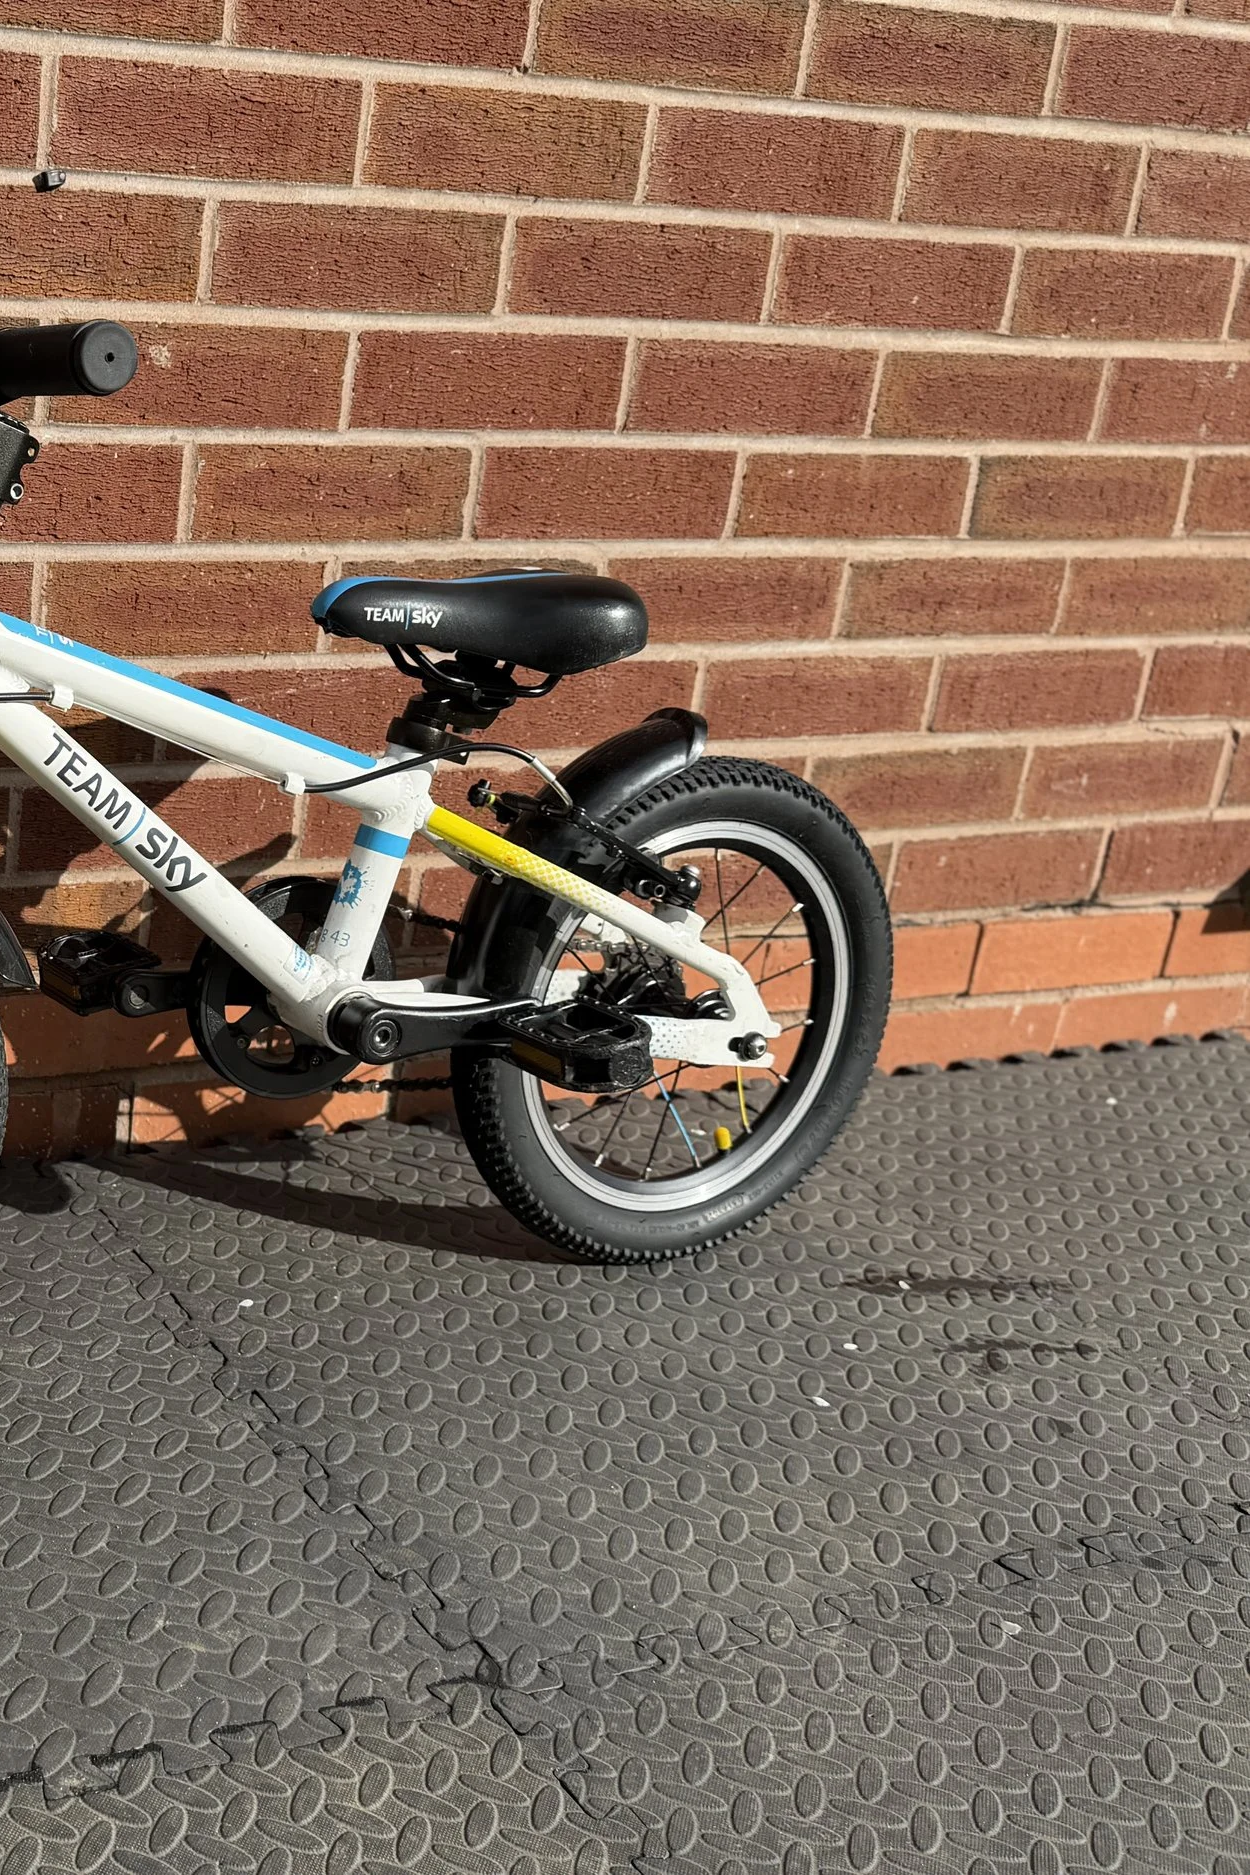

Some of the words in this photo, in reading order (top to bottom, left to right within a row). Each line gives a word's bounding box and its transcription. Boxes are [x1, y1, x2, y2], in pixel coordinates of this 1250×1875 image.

[363, 606, 405, 623] TEAM
[411, 606, 444, 629] sky
[43, 732, 132, 831] TEAM
[329, 929, 351, 948] 43
